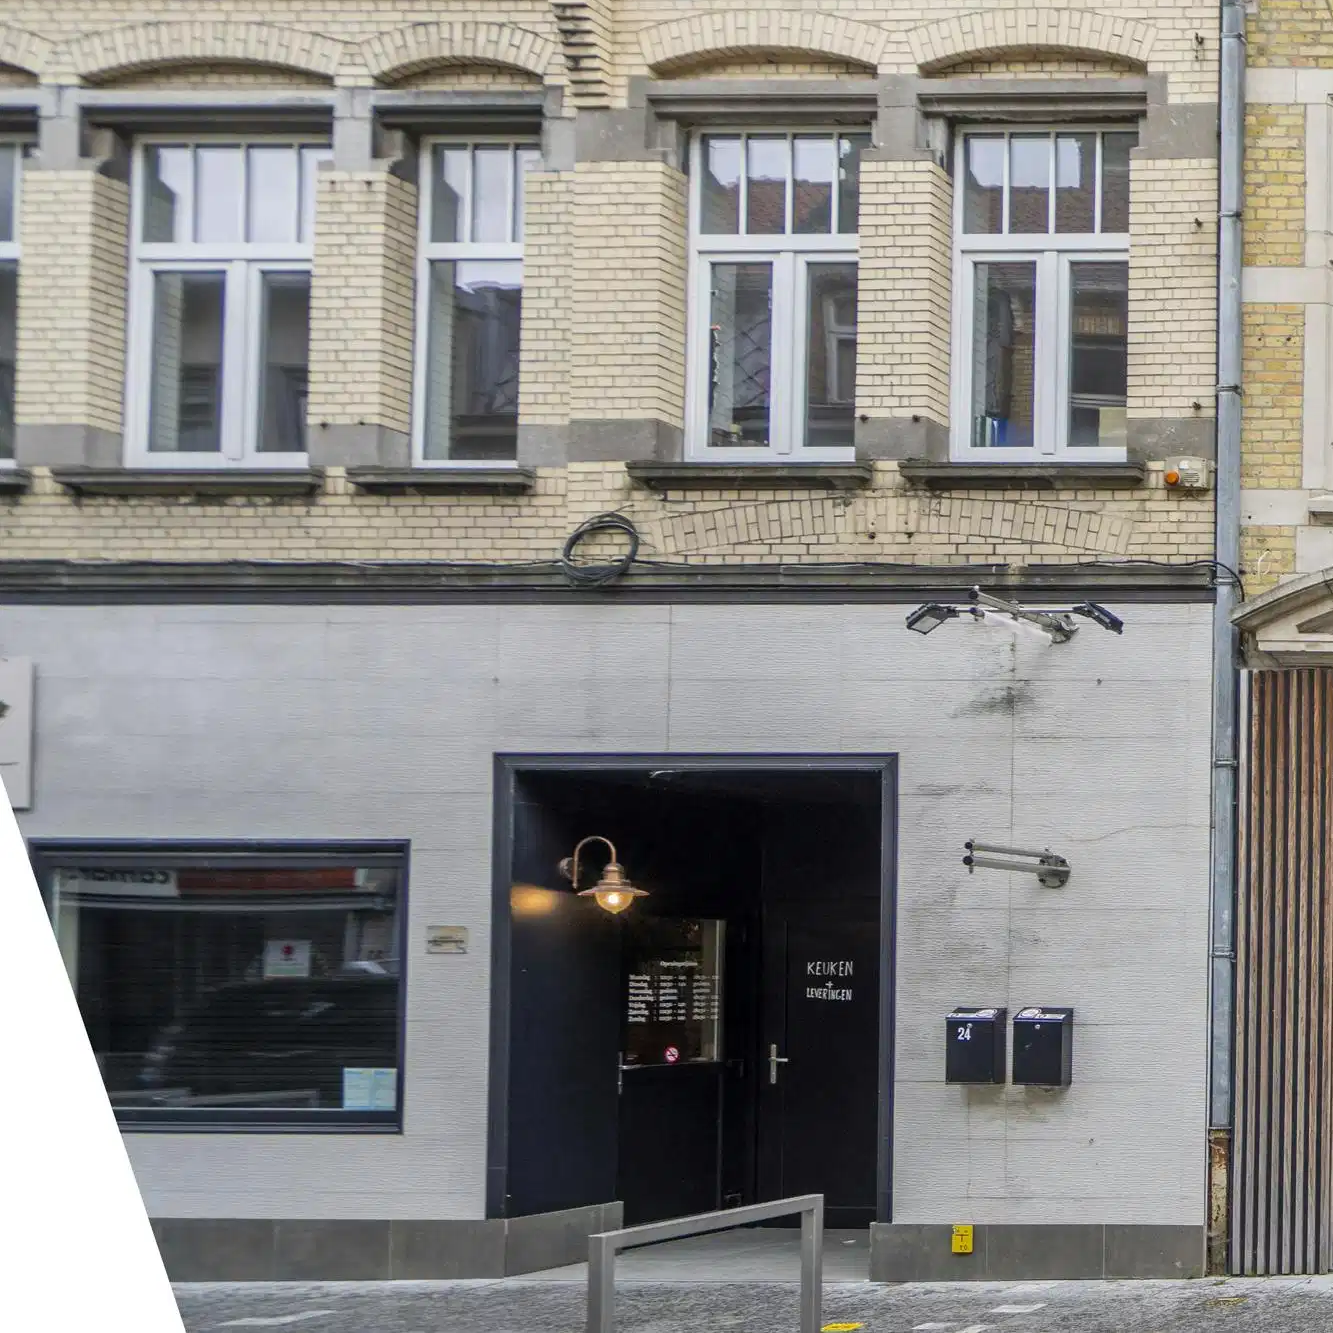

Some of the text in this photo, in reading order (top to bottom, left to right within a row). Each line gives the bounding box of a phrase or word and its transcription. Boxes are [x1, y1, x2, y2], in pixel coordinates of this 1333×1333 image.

[807, 961, 853, 976] KEUKEN
[806, 987, 852, 1001] LEVERINGEN
[957, 1027, 971, 1041] 24
